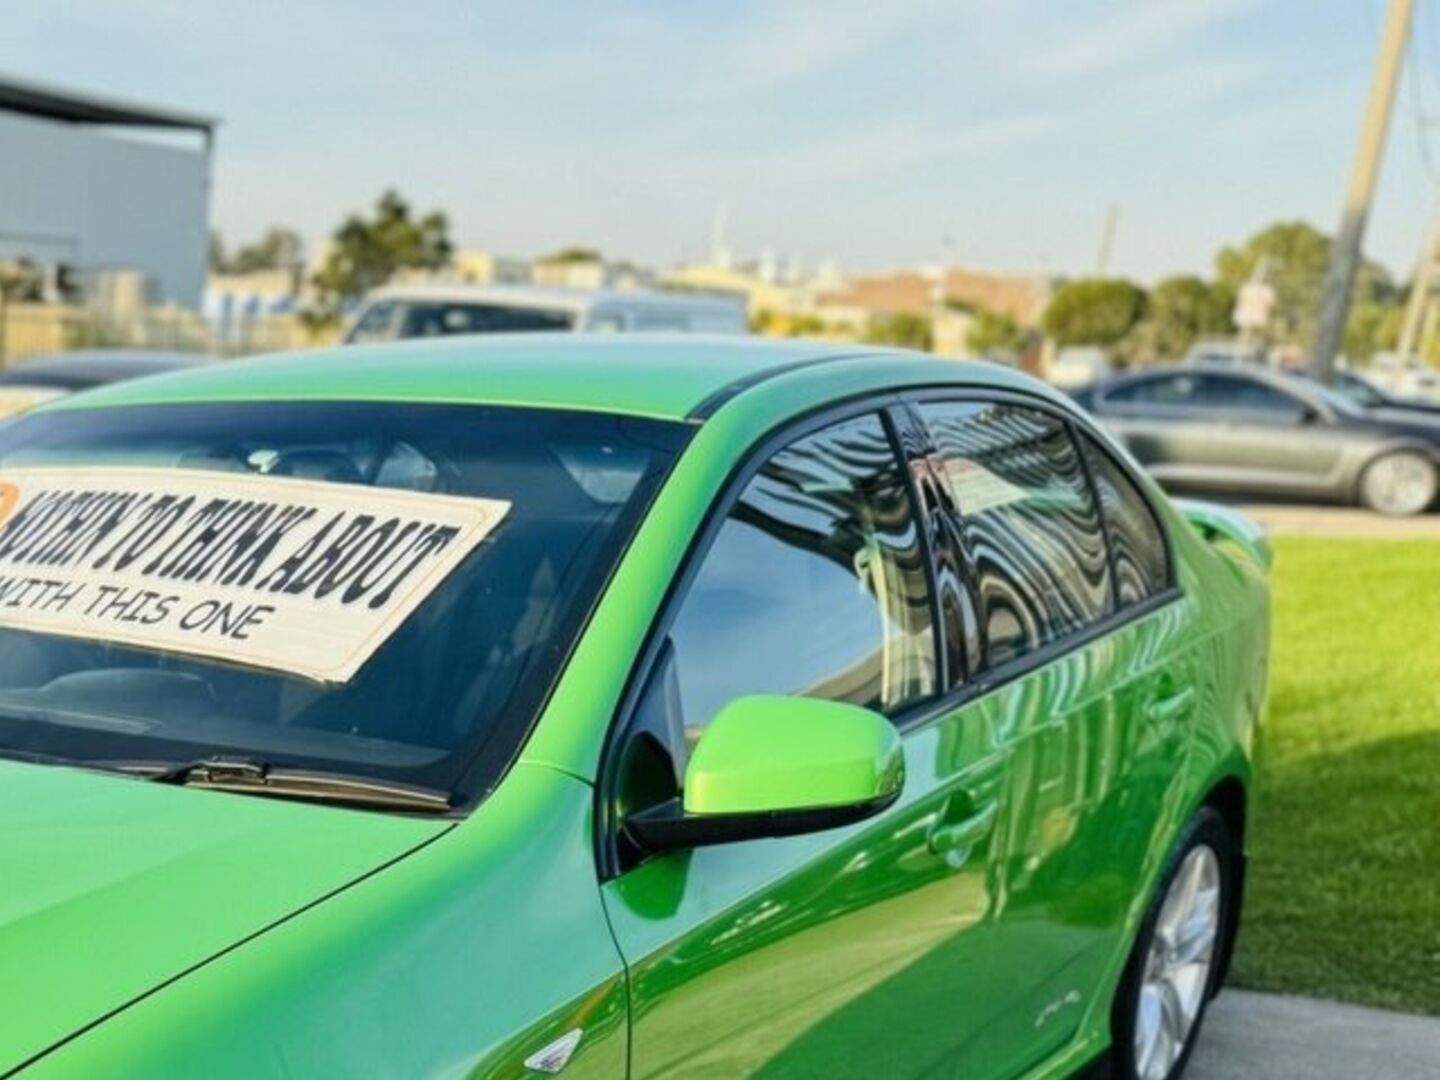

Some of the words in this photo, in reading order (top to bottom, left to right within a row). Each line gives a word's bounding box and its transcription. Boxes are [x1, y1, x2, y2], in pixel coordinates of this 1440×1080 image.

[92, 494, 197, 573] TO
[142, 498, 319, 587] THINK
[254, 510, 461, 609] ABOUT
[83, 584, 180, 625] THIS
[178, 599, 276, 640] ONE
